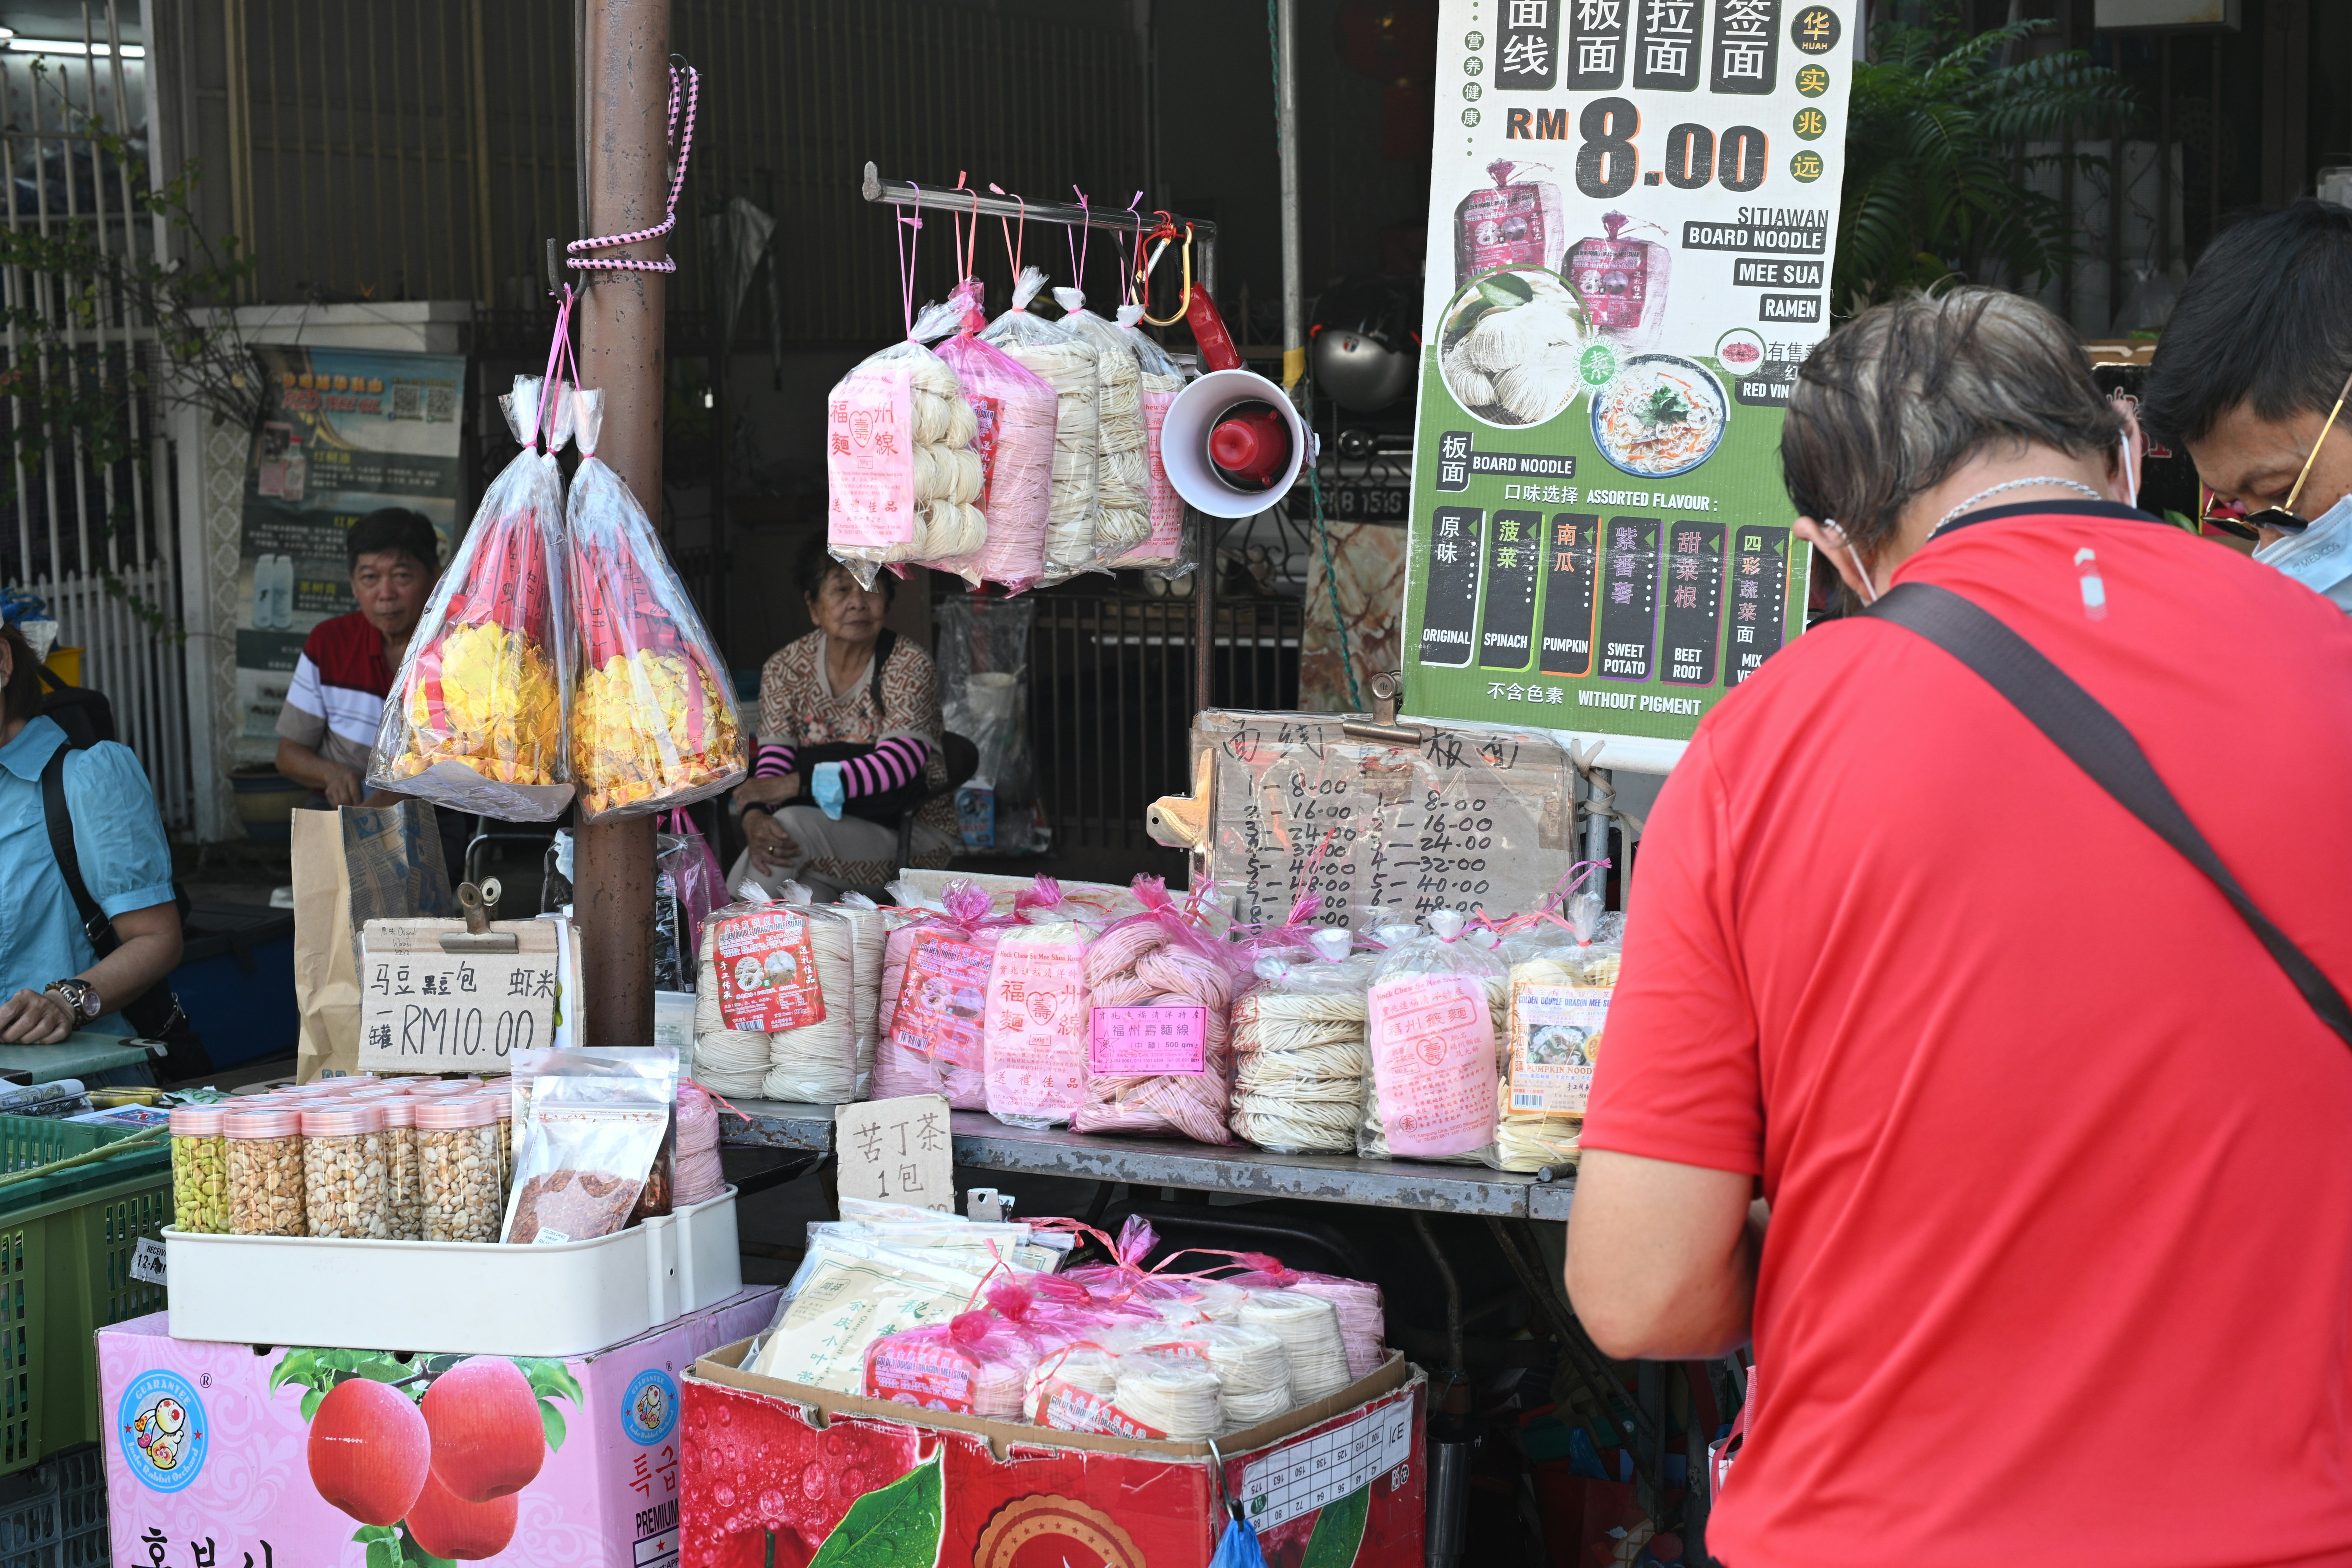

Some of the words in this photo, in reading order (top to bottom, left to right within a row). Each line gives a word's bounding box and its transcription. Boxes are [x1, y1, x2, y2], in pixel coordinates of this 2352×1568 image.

[1503, 0, 1548, 75] 面线
[1577, 0, 1621, 74] 板面
[1646, 0, 1693, 76] 拉面
[1802, 42, 1827, 50] HUAH
[1463, 33, 1482, 125] 营养健康
[1506, 107, 1569, 141] RM
[1575, 97, 1769, 199] 8.00
[1738, 206, 1829, 227] SITIAWAN
[1689, 228, 1748, 246] BOARD
[1754, 231, 1822, 248] NOODLE
[1739, 264, 1778, 282] MEE
[1783, 265, 1819, 284] SUA
[1766, 299, 1816, 317] RAMEN
[1743, 382, 1766, 397] RED
[282, 390, 320, 410] RED
[323, 396, 357, 410] TREE
[358, 397, 382, 412] OIL
[980, 410, 994, 419] SUAH
[1442, 436, 1467, 483] 板面
[1473, 456, 1517, 471] BOARD
[1521, 458, 1572, 474] NOODLE
[1505, 484, 1578, 505] 口味选择
[1587, 489, 1649, 508] ASSORTED
[1653, 494, 1710, 512] FLAVOUR
[1437, 516, 1460, 563] 原味
[1497, 520, 1521, 569] 菠菜
[1554, 523, 1577, 572] 南瓜
[2301, 542, 2340, 568] MEDICOS
[1611, 527, 1638, 604] 紫番薯
[1674, 532, 1702, 609] 甜菜根
[1737, 535, 1762, 643] 四彩蔬菜面
[1423, 628, 1470, 644] ORIGINAL
[1484, 632, 1528, 649] SPINACH
[1543, 637, 1588, 654] PUMPKIN
[1608, 642, 1645, 658] SWEET
[1674, 648, 1702, 662] BEET
[1741, 653, 1762, 668] MIX
[1604, 658, 1645, 675] POTATO
[1673, 664, 1703, 679] ROOT
[1487, 682, 1563, 705] 不含色素
[1578, 690, 1635, 710] WITHOUT
[1639, 695, 1701, 716] PIGMENT
[1371, 873, 1388, 889] 5
[1371, 889, 1382, 906] 6
[719, 932, 734, 942] GOLDEN
[735, 928, 752, 938] DOUBLE
[754, 924, 774, 934] DRAGON
[775, 922, 786, 930] MEE
[788, 919, 801, 929] SUAH
[800, 945, 816, 984] 送礼佳品
[920, 944, 940, 956] GOLDEN
[941, 949, 961, 962] DOUBLE
[961, 956, 980, 968] DRAGON
[1395, 986, 1413, 995] Chew
[1519, 996, 1538, 1004] GOLDEN
[1541, 997, 1563, 1006] DOUBLE
[1564, 998, 1587, 1007] DRAGON
[401, 1004, 534, 1057] RM10.00
[1113, 1024, 1188, 1036] 福州壽麵線
[1515, 1024, 1526, 1072] 南瓜板麵
[1526, 1065, 1565, 1073] PUMPKIN
[994, 1071, 1078, 1088] 送禮佳品
[1402, 1117, 1414, 1130] 素
[853, 1113, 946, 1164] 苦丁茶
[851, 1315, 868, 1333] Qing
[836, 1334, 854, 1356] Small
[877, 1356, 896, 1367] GOLDEN
[897, 1360, 916, 1371] DOUBLE
[918, 1363, 939, 1374] DRAGON
[941, 1367, 952, 1377] MEE
[954, 1371, 968, 1381] SUAH
[136, 1379, 191, 1406] GUARANTEE
[632, 1376, 664, 1394] GUARANTEE
[641, 1430, 658, 1439] Rabbit
[659, 1409, 674, 1433] Orchard
[1051, 1395, 1073, 1412] GOLDEN
[1076, 1407, 1099, 1422] DOUBLE
[1100, 1417, 1122, 1437] DRAGON
[1356, 1440, 1364, 1452] 113
[1371, 1431, 1379, 1443] 100
[1316, 1457, 1327, 1469] 138
[1337, 1449, 1348, 1461] 125
[142, 1465, 171, 1483] Rabbit
[172, 1447, 198, 1481] Orchard
[629, 1445, 678, 1499] 특급
[1295, 1465, 1306, 1477] 150
[1251, 1482, 1262, 1495] 175
[1273, 1474, 1284, 1486] 163
[1338, 1484, 1345, 1494] 56
[1296, 1501, 1304, 1511] 72
[1317, 1492, 1324, 1503] 64
[636, 1498, 679, 1538] PREMIUM
[1275, 1509, 1282, 1520] 80
